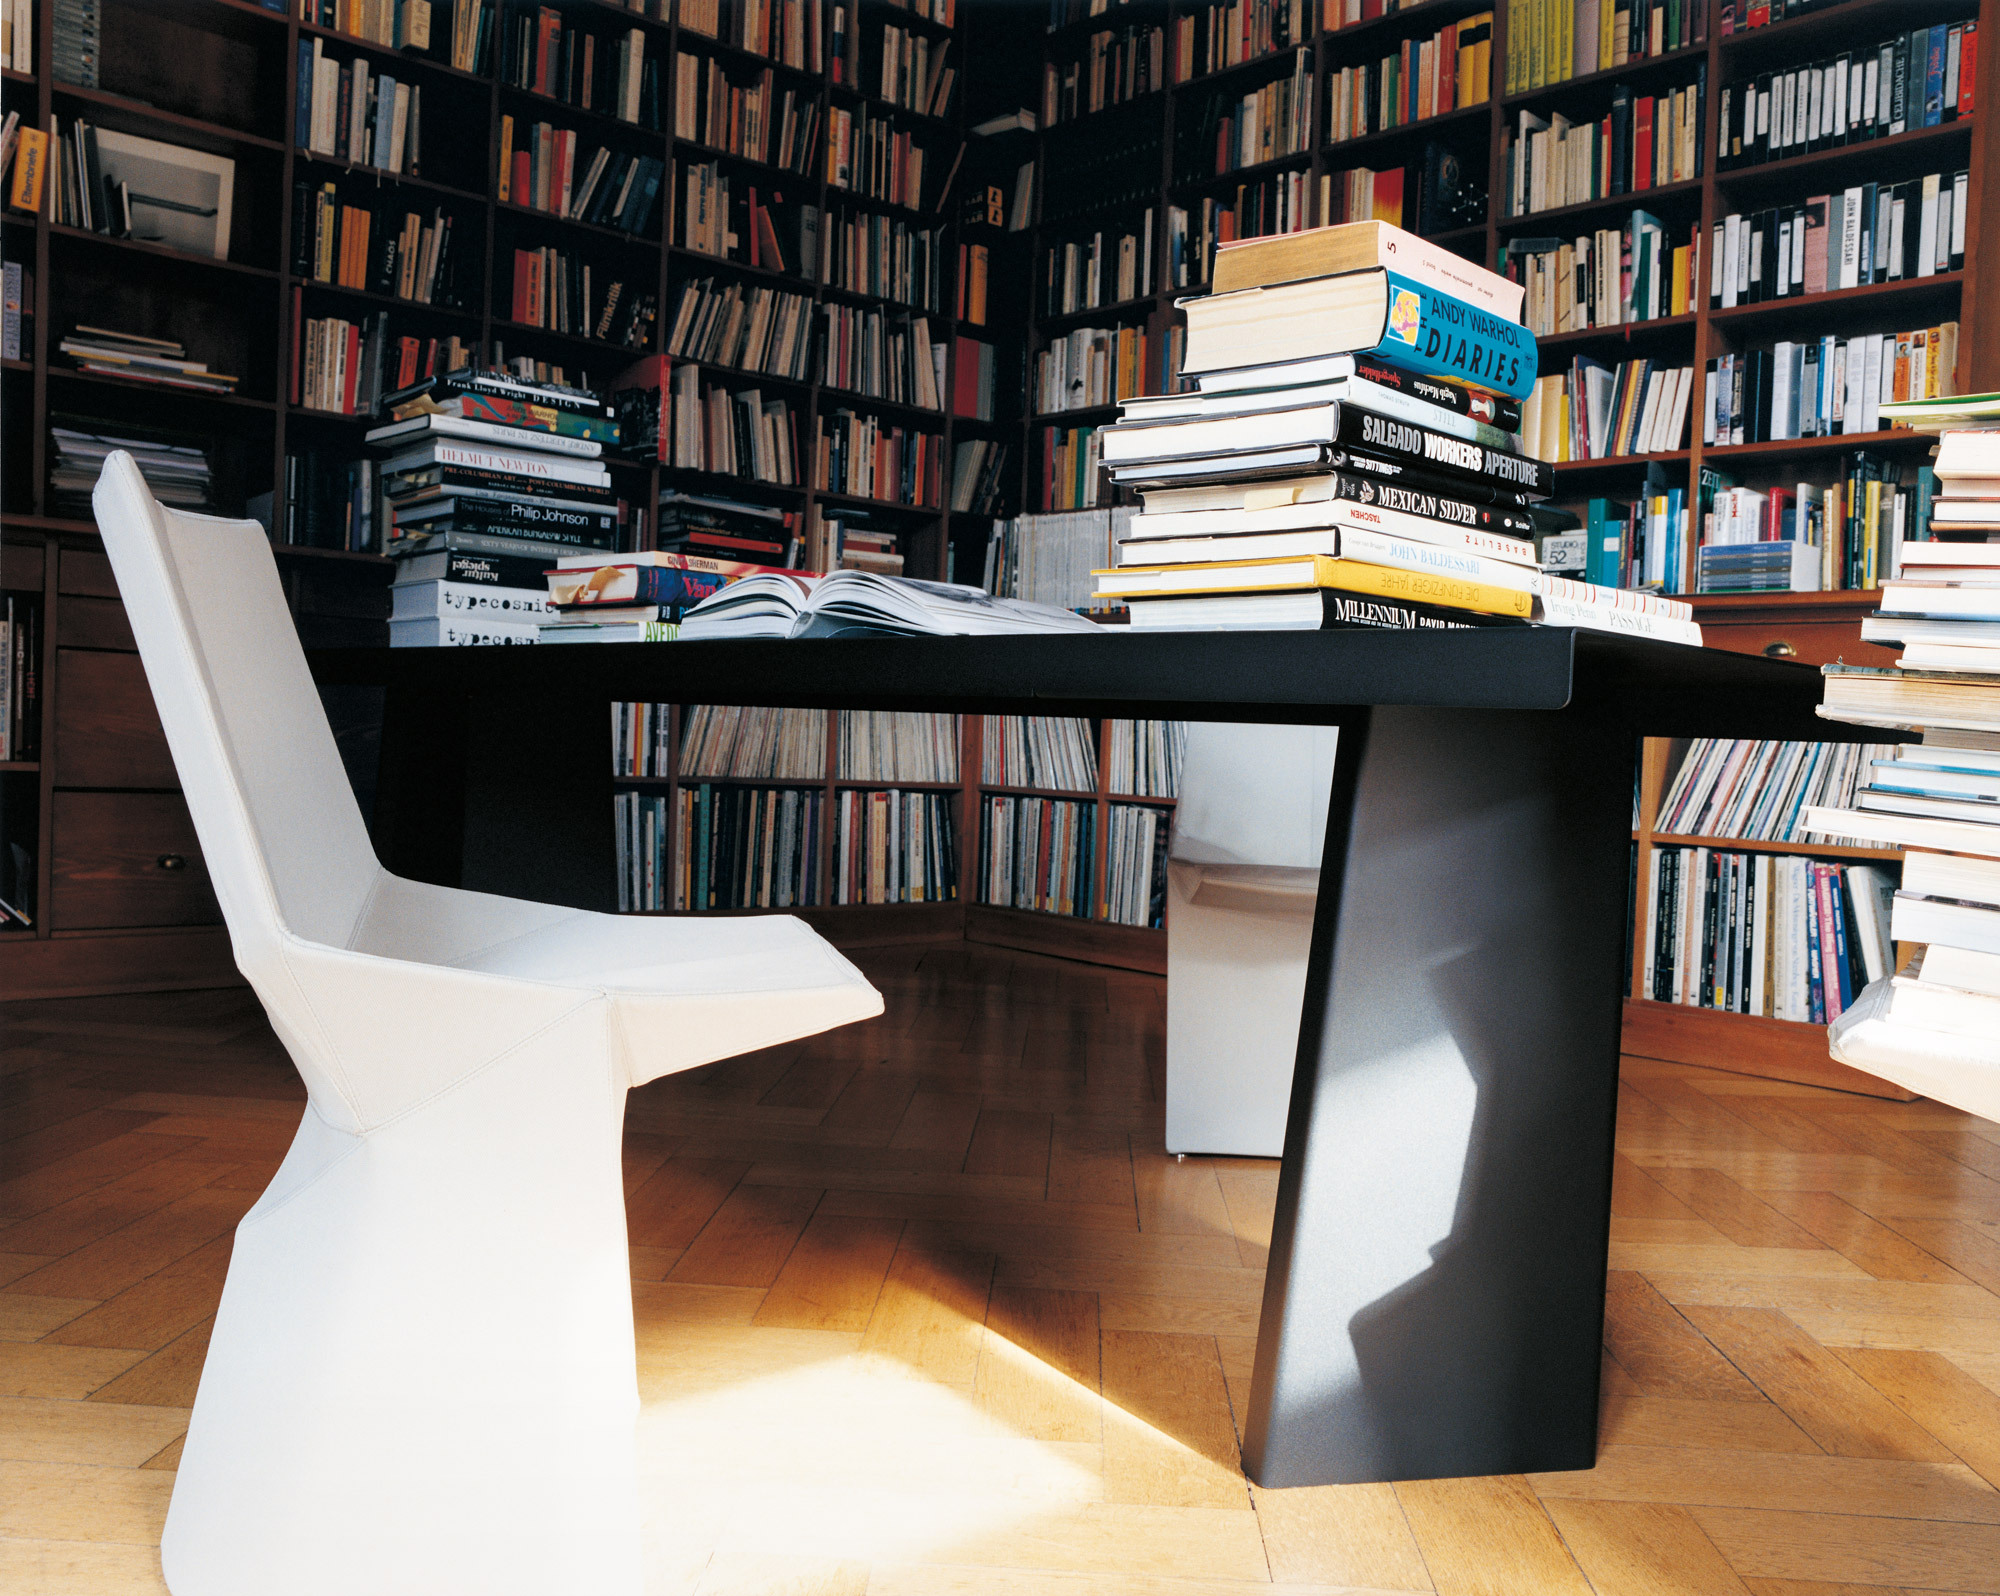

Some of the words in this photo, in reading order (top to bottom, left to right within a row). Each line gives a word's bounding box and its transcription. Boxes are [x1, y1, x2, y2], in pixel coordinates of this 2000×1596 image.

[1894, 57, 1904, 120] CELIBIDACHE
[21, 148, 37, 205] Elternbriefe
[1846, 197, 1856, 217] JOHN
[1387, 242, 1396, 253] 5
[1844, 219, 1856, 266] BALDESSARI
[385, 240, 396, 275] CHAOS
[595, 281, 623, 339] Filmkritik
[1432, 297, 1466, 327] ANDY
[1469, 311, 1521, 348] WARHOL
[1424, 328, 1520, 386] DIARIES
[1358, 364, 1402, 388] Spiegelbilder
[447, 379, 472, 391] Frank
[474, 383, 498, 395] Lloyd
[500, 388, 527, 400] Wright
[533, 394, 581, 409] DESIGN
[493, 426, 518, 437] PARIS
[518, 431, 528, 440] IN
[442, 449, 493, 467] HELMUT
[498, 457, 549, 474] NEWTON
[1362, 415, 1422, 454] SALGADO
[1424, 432, 1482, 472] WORKERS
[1484, 451, 1538, 486] APERTURE
[1365, 459, 1393, 476] SITTINGS
[1702, 469, 1720, 489] ZEIT
[444, 466, 501, 480] PRE-COLUMBIAN
[528, 478, 585, 492] POST-COLUMBIAN
[587, 486, 610, 495] WORLD
[460, 502, 473, 510] The
[475, 503, 501, 513] Houses
[503, 506, 510, 514] of
[511, 504, 541, 521] Philip
[541, 507, 589, 526] Johnson
[1350, 508, 1381, 524] TASCHEN
[1377, 485, 1437, 516] MEXICAN
[1439, 499, 1477, 525] SILVER
[487, 524, 523, 537] AMERICAN
[523, 529, 561, 541] BUNGALOW
[562, 533, 581, 543] STYLE
[1465, 535, 1527, 556] BASELITZ
[452, 560, 490, 571] spiegel
[688, 556, 718, 570] SHERMAN
[1389, 543, 1417, 560] JOHN
[1421, 551, 1480, 575] BALDESSARI
[1550, 551, 1567, 564] 52
[462, 570, 499, 582] Kultur
[1381, 572, 1409, 589] JAHRE
[444, 589, 555, 614] typecosmic
[1465, 588, 1480, 602] DIE
[1335, 598, 1416, 629] MILLENNIUM
[1419, 617, 1445, 628] DAVID
[1550, 599, 1574, 617] Irving
[1578, 603, 1597, 619] Penn
[1609, 610, 1655, 634] PASSAGE
[1820, 877, 1831, 915] WAGNER
[1811, 950, 1819, 978] WAGNER
